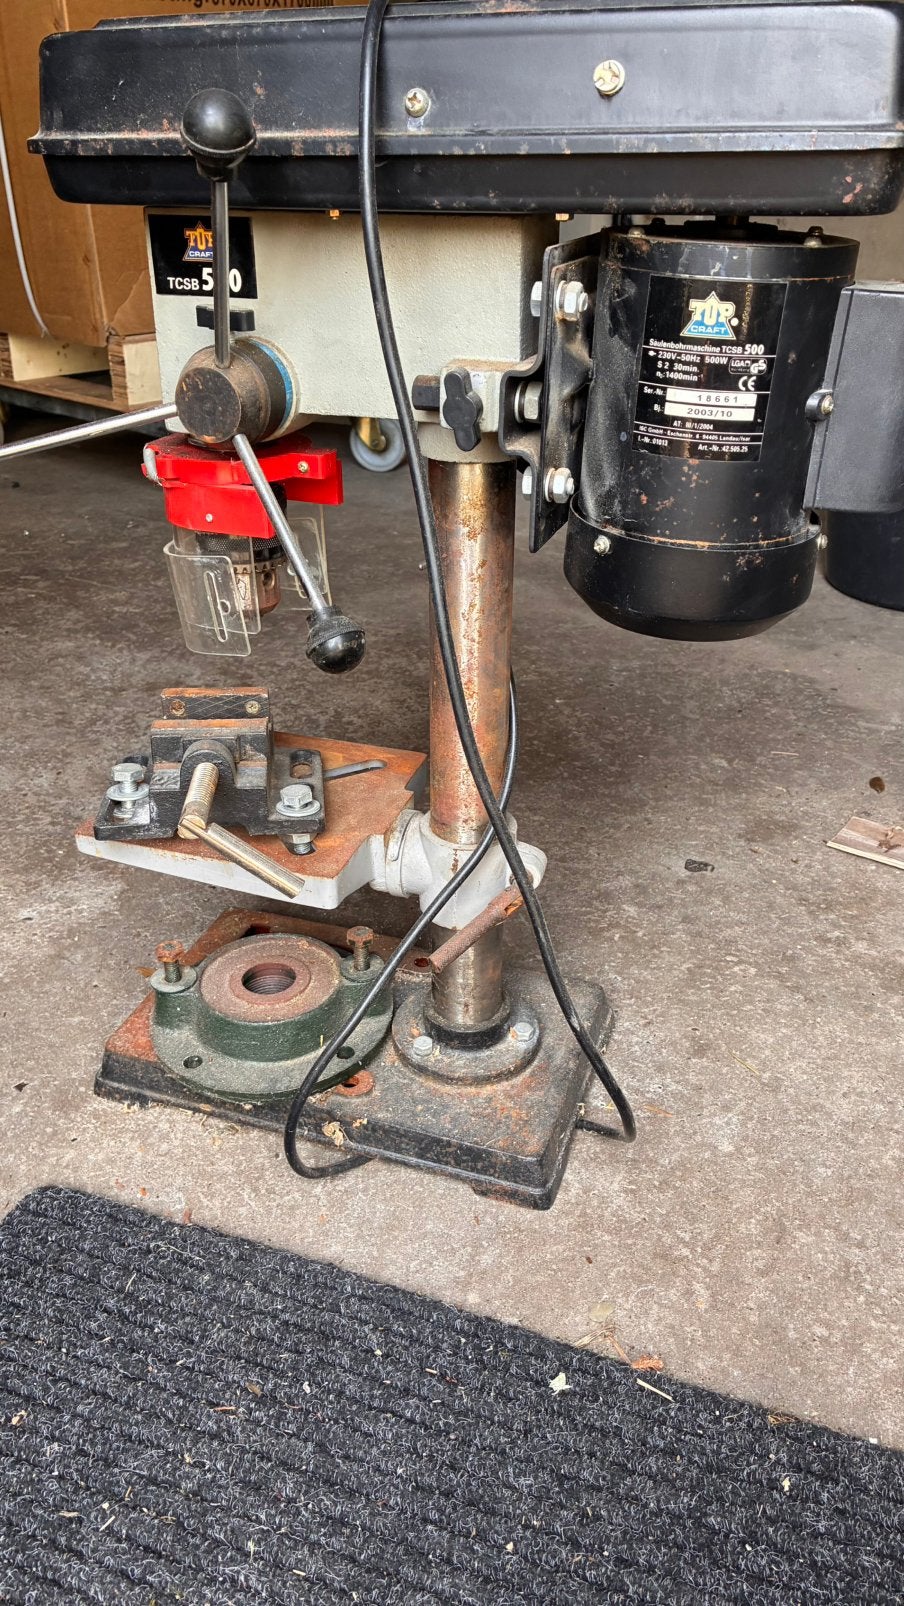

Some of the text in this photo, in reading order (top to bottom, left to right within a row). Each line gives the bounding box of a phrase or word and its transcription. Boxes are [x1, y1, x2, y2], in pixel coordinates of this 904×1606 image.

[167, 267, 242, 293] TCSB 50
[690, 325, 726, 334] CRAFT
[721, 345, 743, 354] TCSB
[744, 344, 765, 355] 500
[705, 355, 729, 365] 500W
[738, 376, 757, 391] CE
[697, 394, 739, 404] 18661
[687, 407, 733, 418] 2003/10
